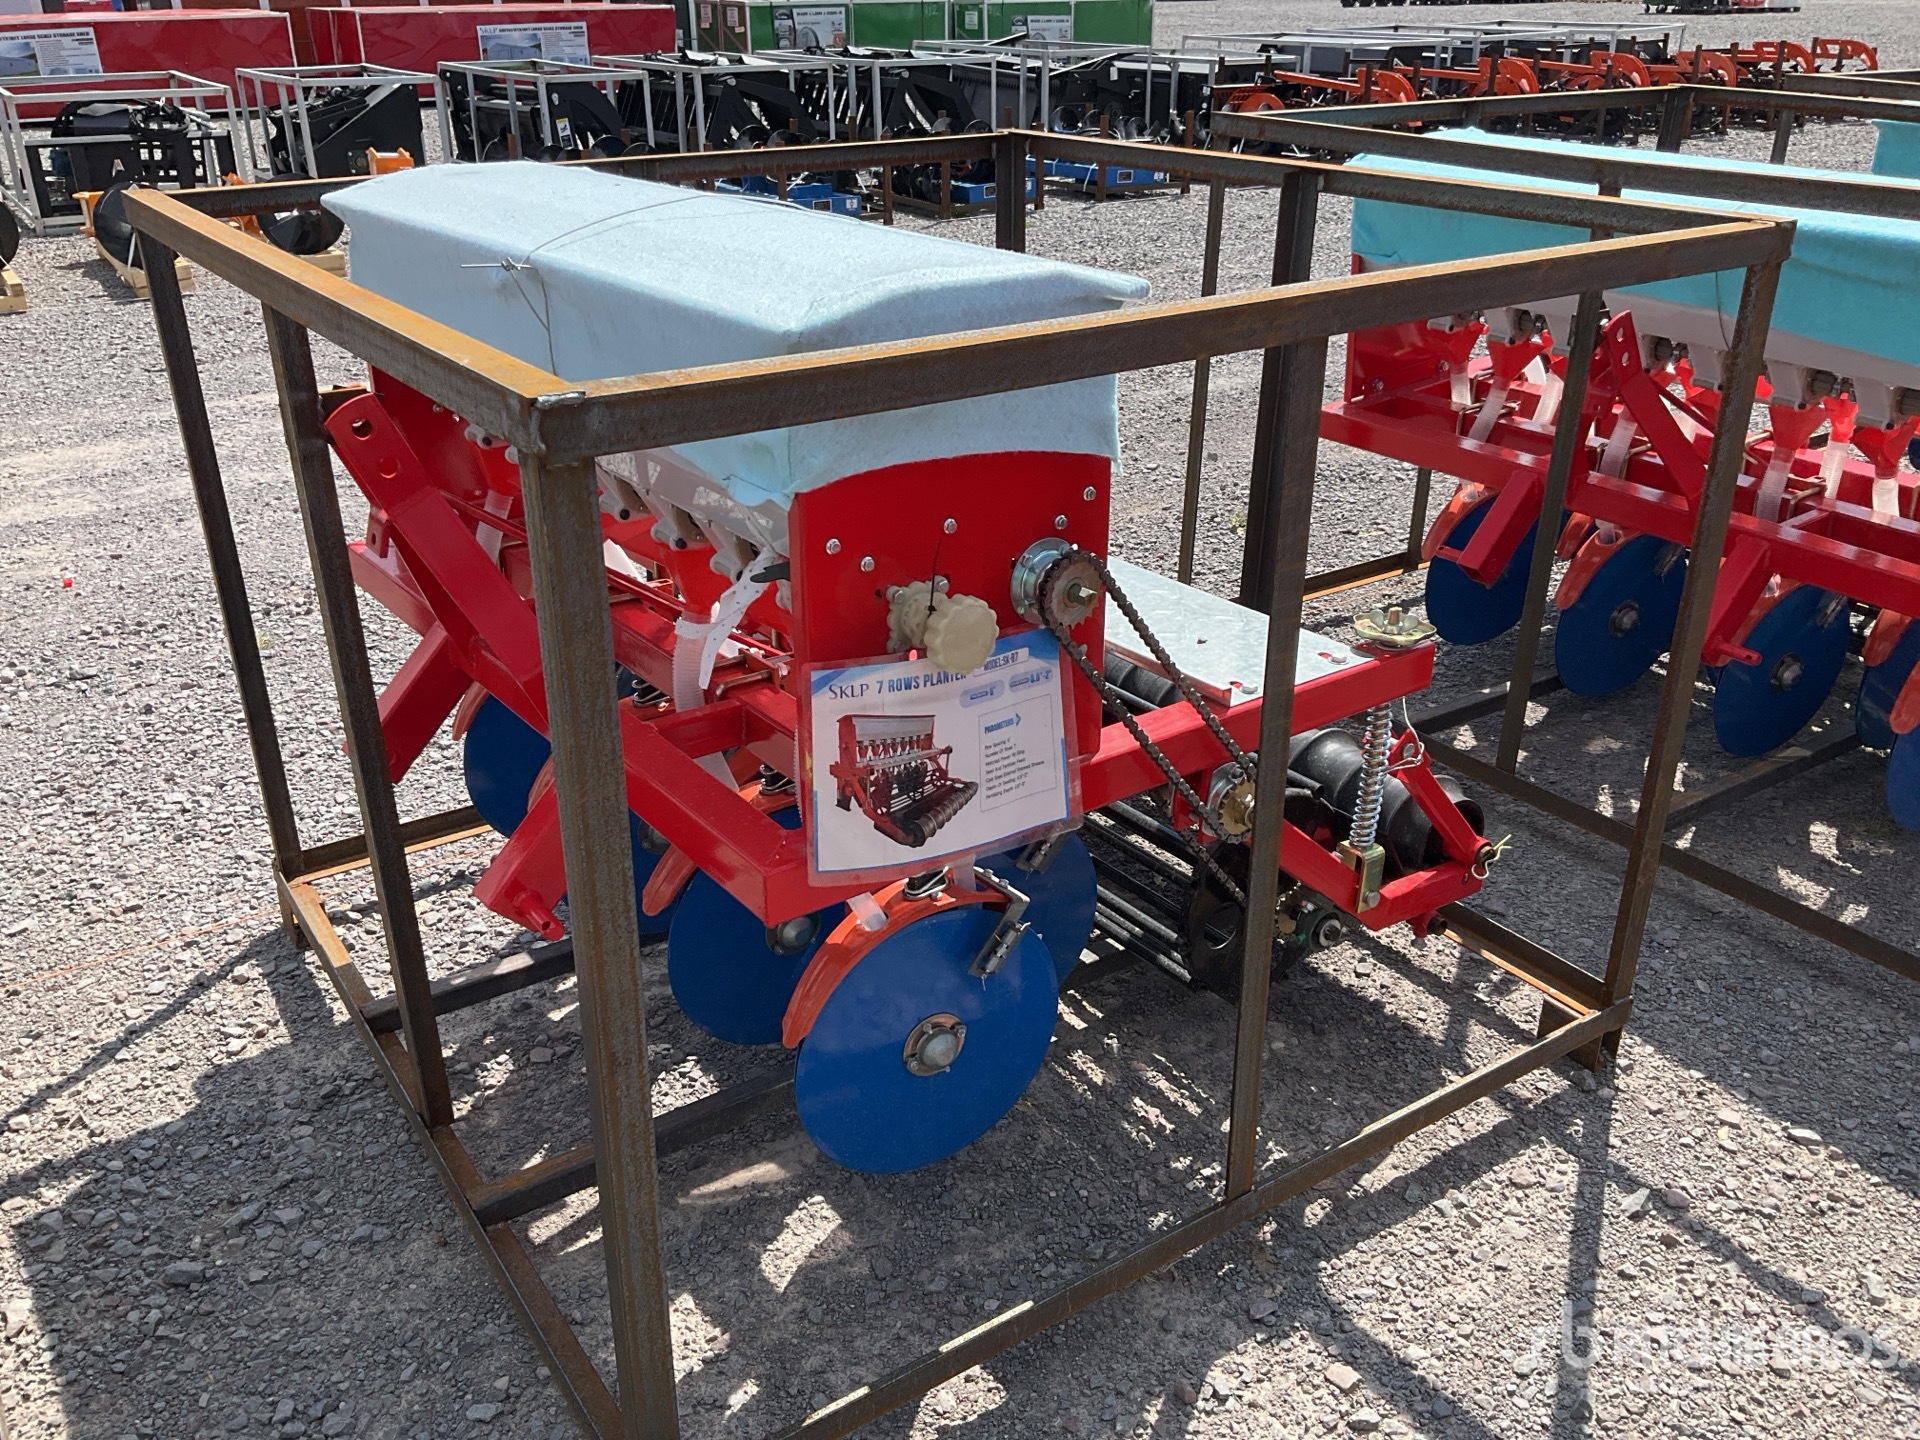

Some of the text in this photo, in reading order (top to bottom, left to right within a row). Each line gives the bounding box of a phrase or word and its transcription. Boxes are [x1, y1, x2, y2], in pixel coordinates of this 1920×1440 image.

[828, 683, 870, 700] SKLP
[876, 680, 884, 694] 7
[888, 675, 920, 692] ROWS
